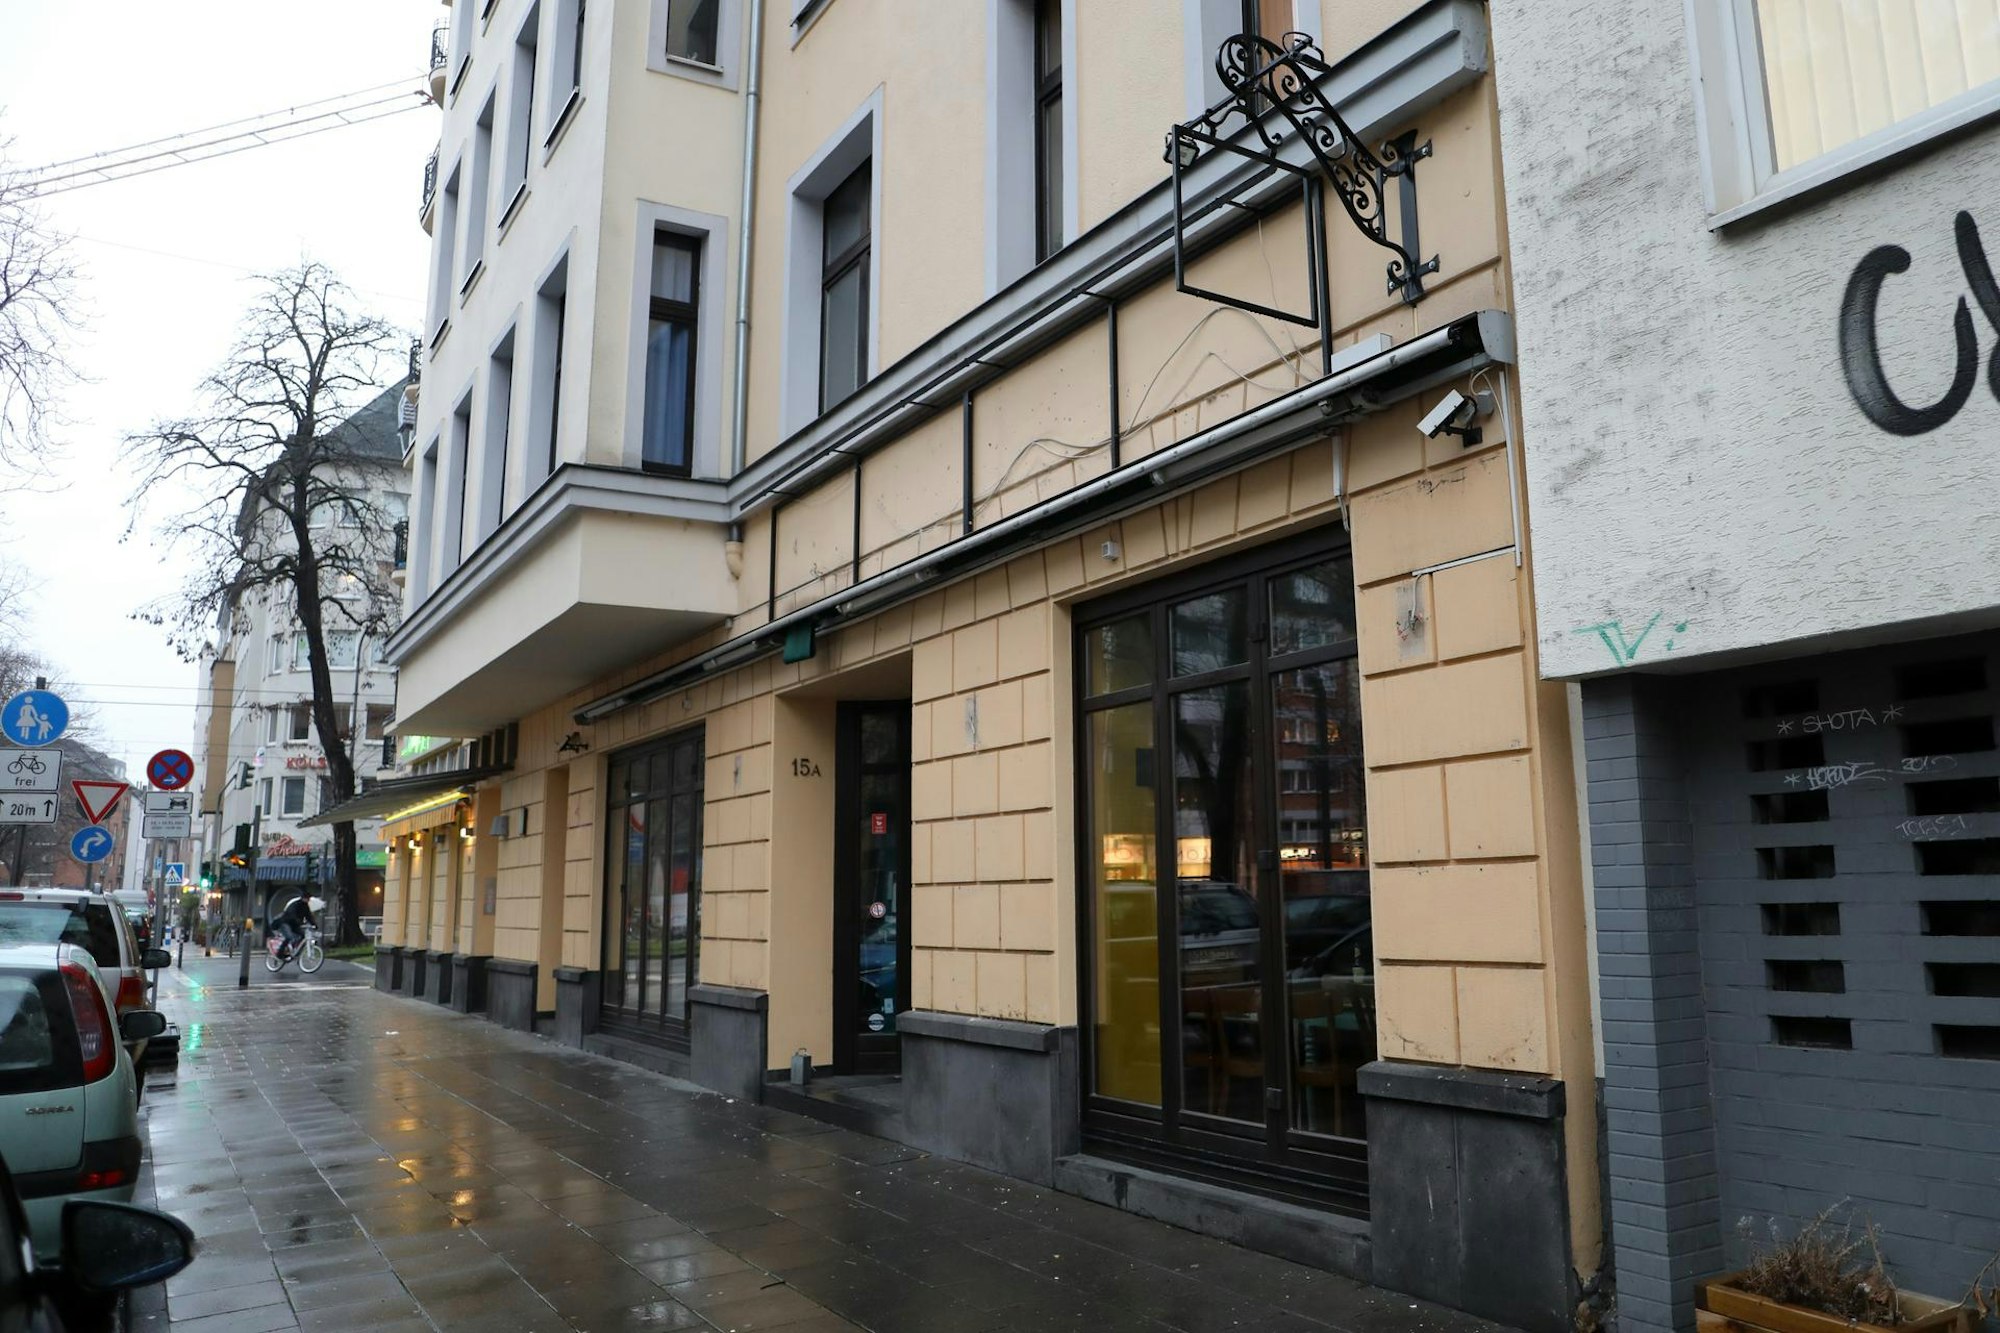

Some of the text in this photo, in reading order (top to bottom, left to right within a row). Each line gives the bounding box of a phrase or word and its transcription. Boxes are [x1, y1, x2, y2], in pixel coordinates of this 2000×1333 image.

[1801, 708, 1877, 733] SHOTA
[791, 758, 821, 777] 15A
[15, 777, 36, 786] frei
[25, 1105, 75, 1115] CORSA
